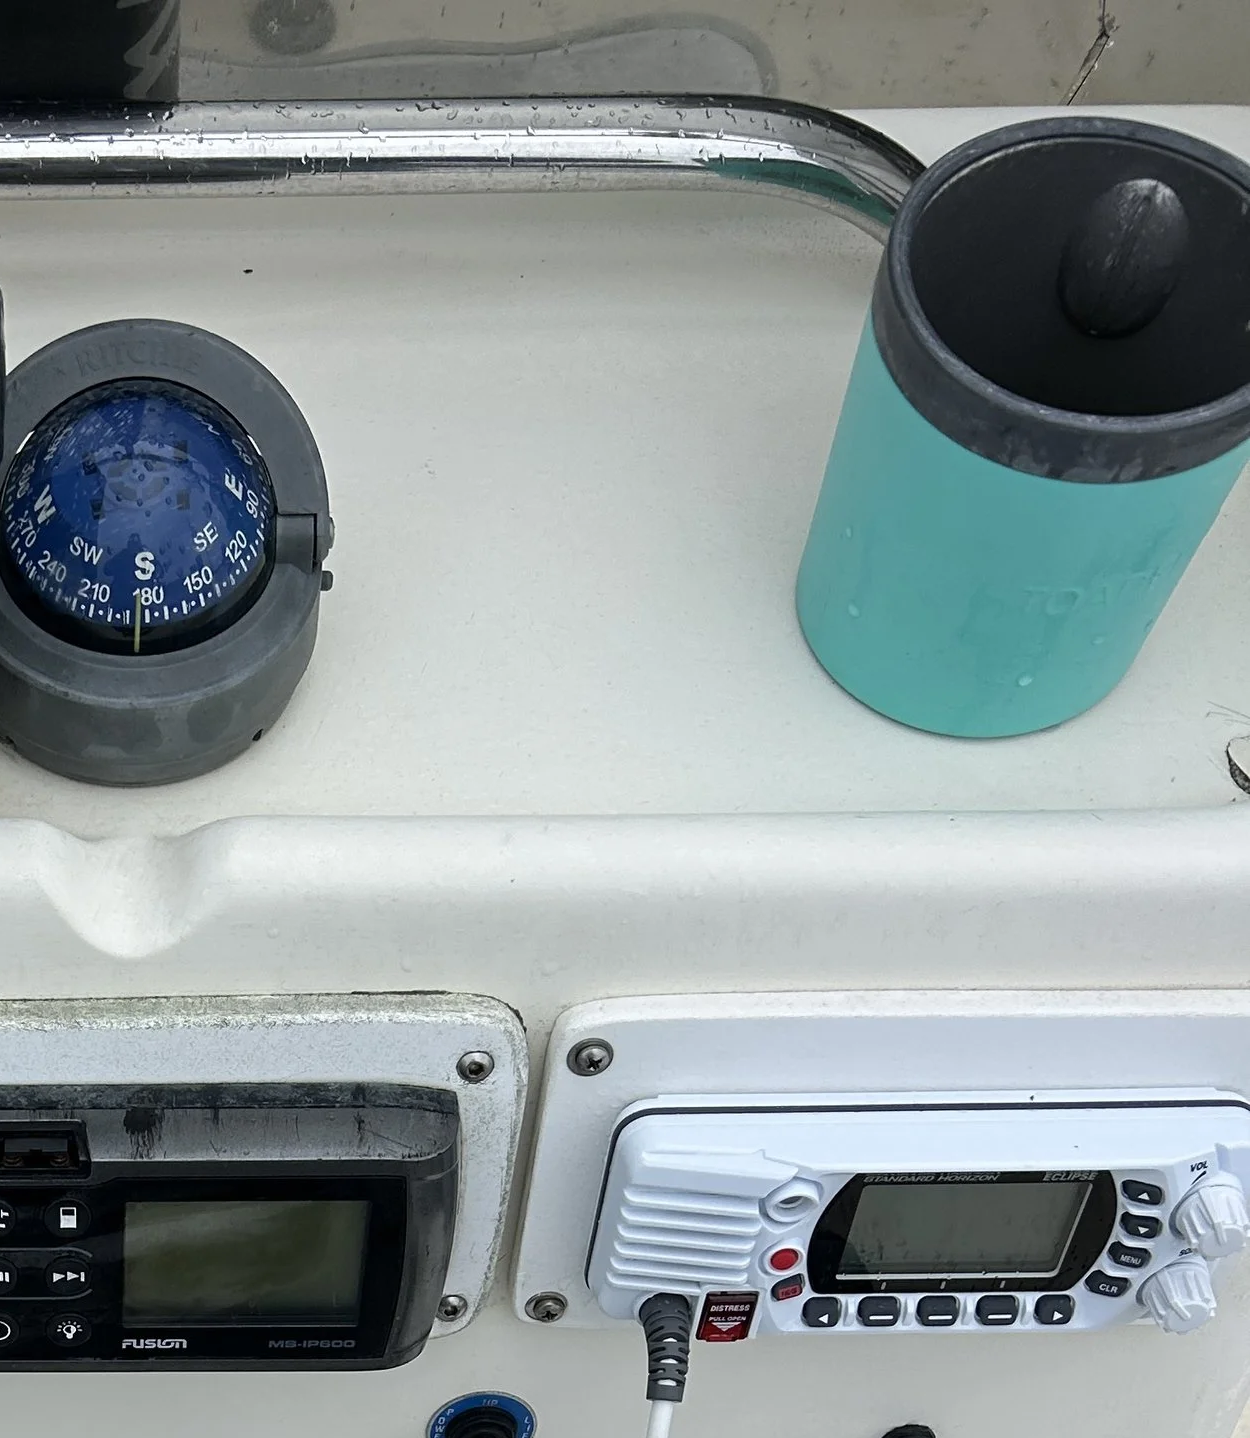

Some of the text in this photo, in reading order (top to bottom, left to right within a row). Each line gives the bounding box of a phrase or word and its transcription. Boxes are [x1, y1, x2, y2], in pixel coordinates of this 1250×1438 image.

[224, 470, 243, 501] E
[33, 484, 56, 524] W
[245, 489, 259, 519] 90
[193, 521, 219, 552] SE
[225, 530, 248, 564] 120
[70, 536, 103, 566] SW
[37, 550, 67, 583] 240
[134, 551, 155, 581] S
[77, 578, 110, 603] 210
[183, 565, 214, 594] 150
[132, 585, 164, 606] 180
[862, 1173, 1000, 1183] STANDARD HORIZON
[1042, 1172, 1099, 1182] ECLIPSE
[1190, 1160, 1209, 1173] VOL
[1119, 1253, 1142, 1265] MENU
[1099, 1282, 1119, 1294] CLR
[710, 1304, 751, 1312] DISTRESS
[121, 1338, 187, 1349] FUSION
[268, 1340, 356, 1349] MS-IP600
